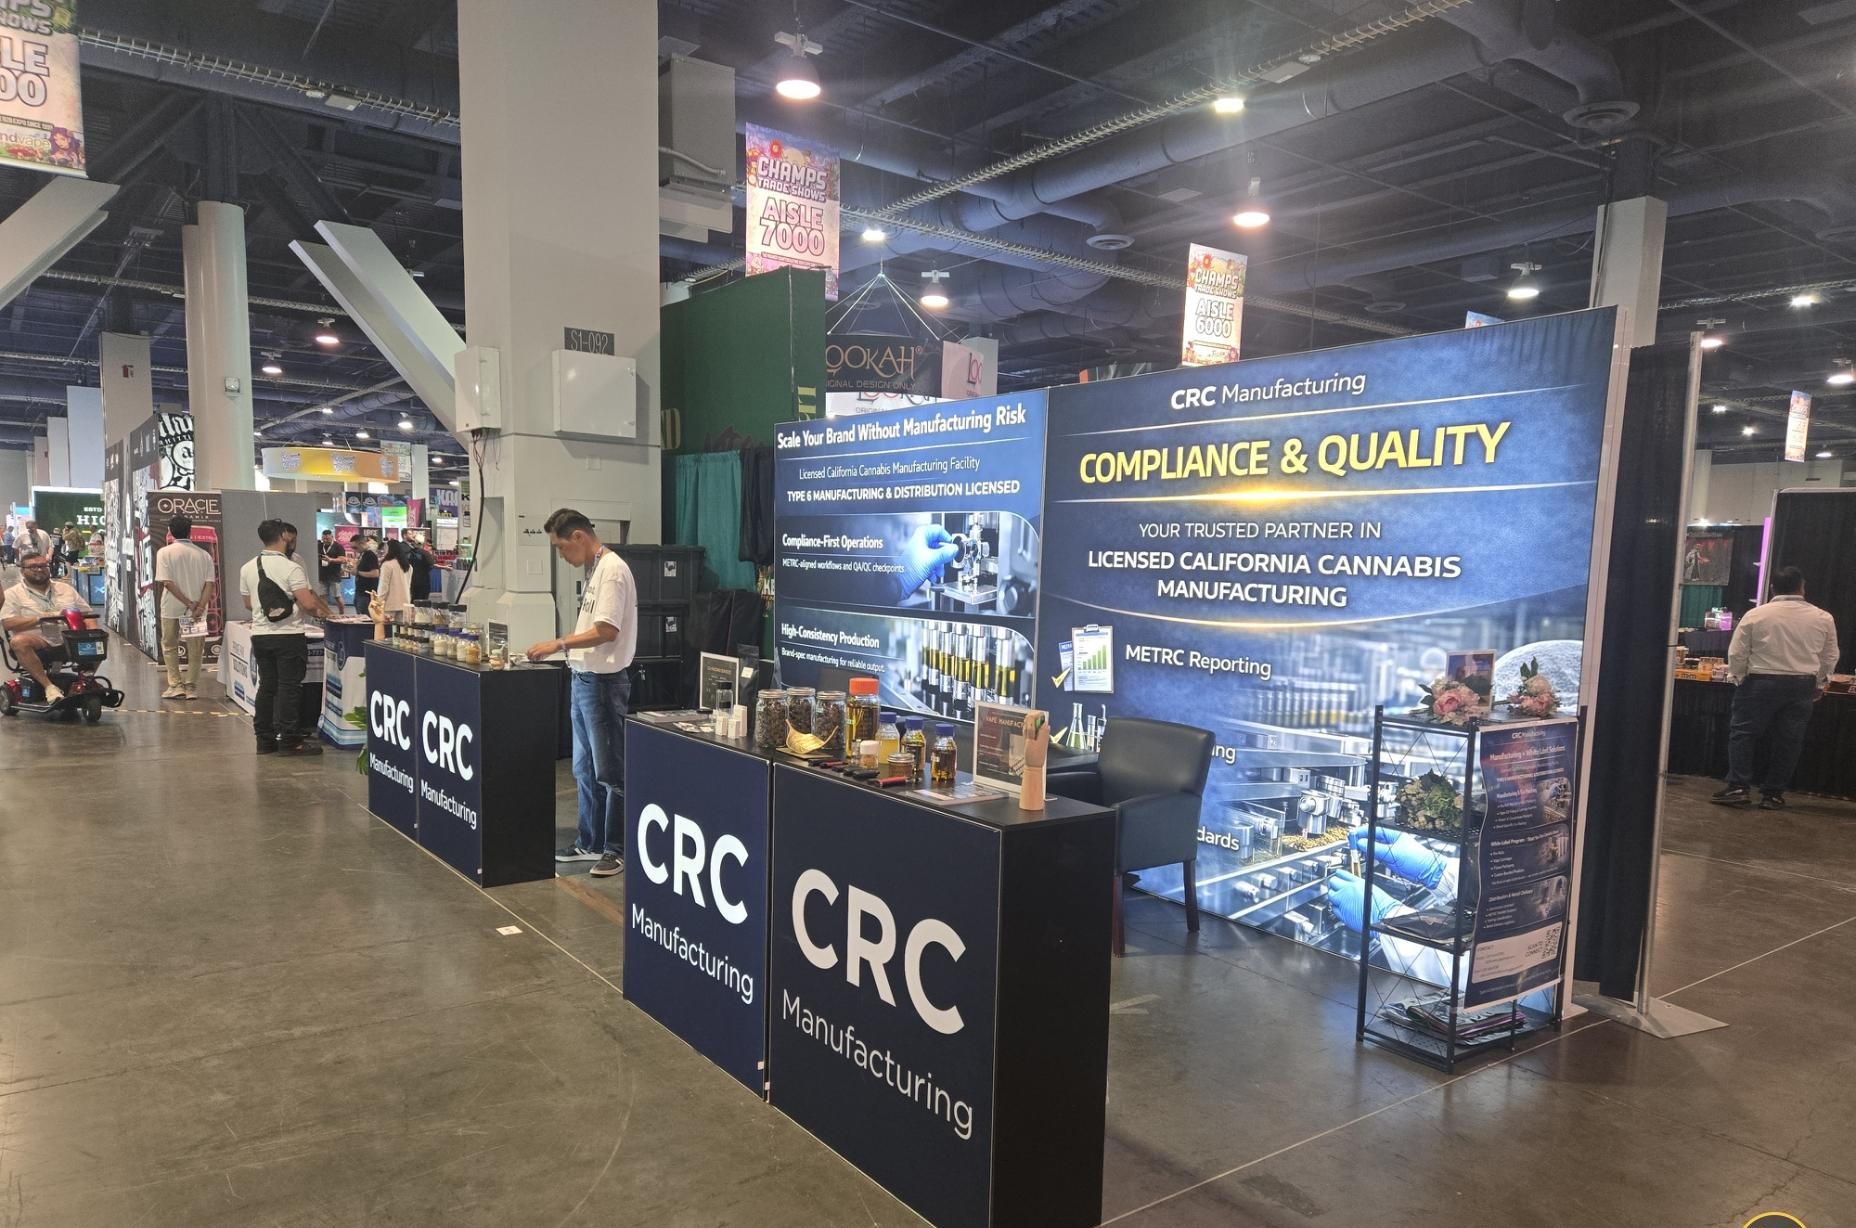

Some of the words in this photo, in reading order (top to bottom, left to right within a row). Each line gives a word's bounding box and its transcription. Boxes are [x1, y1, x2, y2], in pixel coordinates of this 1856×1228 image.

[0, 36, 50, 77] LE
[0, 68, 47, 107] 00
[757, 156, 827, 190] CHAMPS
[758, 177, 790, 194] TRADE
[791, 185, 827, 203] SHOWS
[763, 197, 824, 231] AISLE
[760, 217, 825, 256] 7000
[1195, 268, 1240, 291] CHAMPS
[1195, 298, 1235, 321] AISLE
[1195, 316, 1232, 338] 6000
[825, 344, 915, 381] OOKAH
[827, 380, 854, 388] IGINAL
[1170, 386, 1217, 410] CRC
[1222, 372, 1366, 404] Manufacturing
[777, 431, 801, 449] Scale
[802, 430, 824, 447] Your
[826, 423, 856, 444] Brand
[858, 421, 900, 441] Without
[903, 409, 992, 433] Manufacturing
[996, 402, 1026, 426] Risk
[799, 466, 826, 480] Licensed
[826, 465, 857, 478] California
[859, 463, 891, 477] Cannabis
[892, 458, 948, 474] Manufacturing
[950, 455, 980, 472] Facility
[1080, 440, 1270, 484] COMPLIANCE
[1280, 438, 1308, 474] &
[1318, 421, 1511, 477] QUALITY
[787, 490, 806, 502] TYPE
[806, 490, 812, 502] 6
[813, 487, 884, 502] MANUFACTURING
[885, 486, 892, 499] &
[894, 482, 962, 499] DISTRIBUTION
[965, 480, 1020, 496] LICENSED
[782, 533, 840, 550] Compliance-First
[841, 535, 884, 551] Operations
[1139, 523, 1180, 539] YOUR
[1184, 522, 1259, 538] TRUSTED
[1264, 522, 1353, 538] PARTNER
[1360, 522, 1381, 538] IN
[817, 561, 842, 570] workflows
[843, 562, 852, 571] and
[853, 562, 872, 572] QA/QC
[872, 562, 905, 574] checkpoints
[1088, 551, 1175, 570] LICENSED
[1179, 552, 1311, 574] CALIFORNIA
[1318, 554, 1462, 578] CANNABIS
[1157, 579, 1347, 607] MANUFACTURING
[781, 623, 838, 646] High-Consistency
[839, 631, 880, 648] Production
[781, 647, 806, 660] Brand-spec
[806, 654, 839, 667] manufacturing
[839, 657, 847, 666] for
[847, 660, 866, 670] reliable
[1125, 644, 1185, 667] METRC
[1189, 651, 1272, 681] Reporting
[370, 689, 411, 752] CRC
[997, 719, 1024, 729] MANUFACT
[422, 710, 474, 781] CRC
[1211, 742, 1236, 764] ing
[369, 752, 414, 794] Manufacturing
[420, 778, 477, 831] Manufacturing
[1196, 827, 1240, 851] dards
[637, 803, 749, 924] CRC
[632, 903, 754, 1004] Manufacturing
[792, 868, 966, 1035] CRC
[783, 989, 974, 1140] Manufacturing
